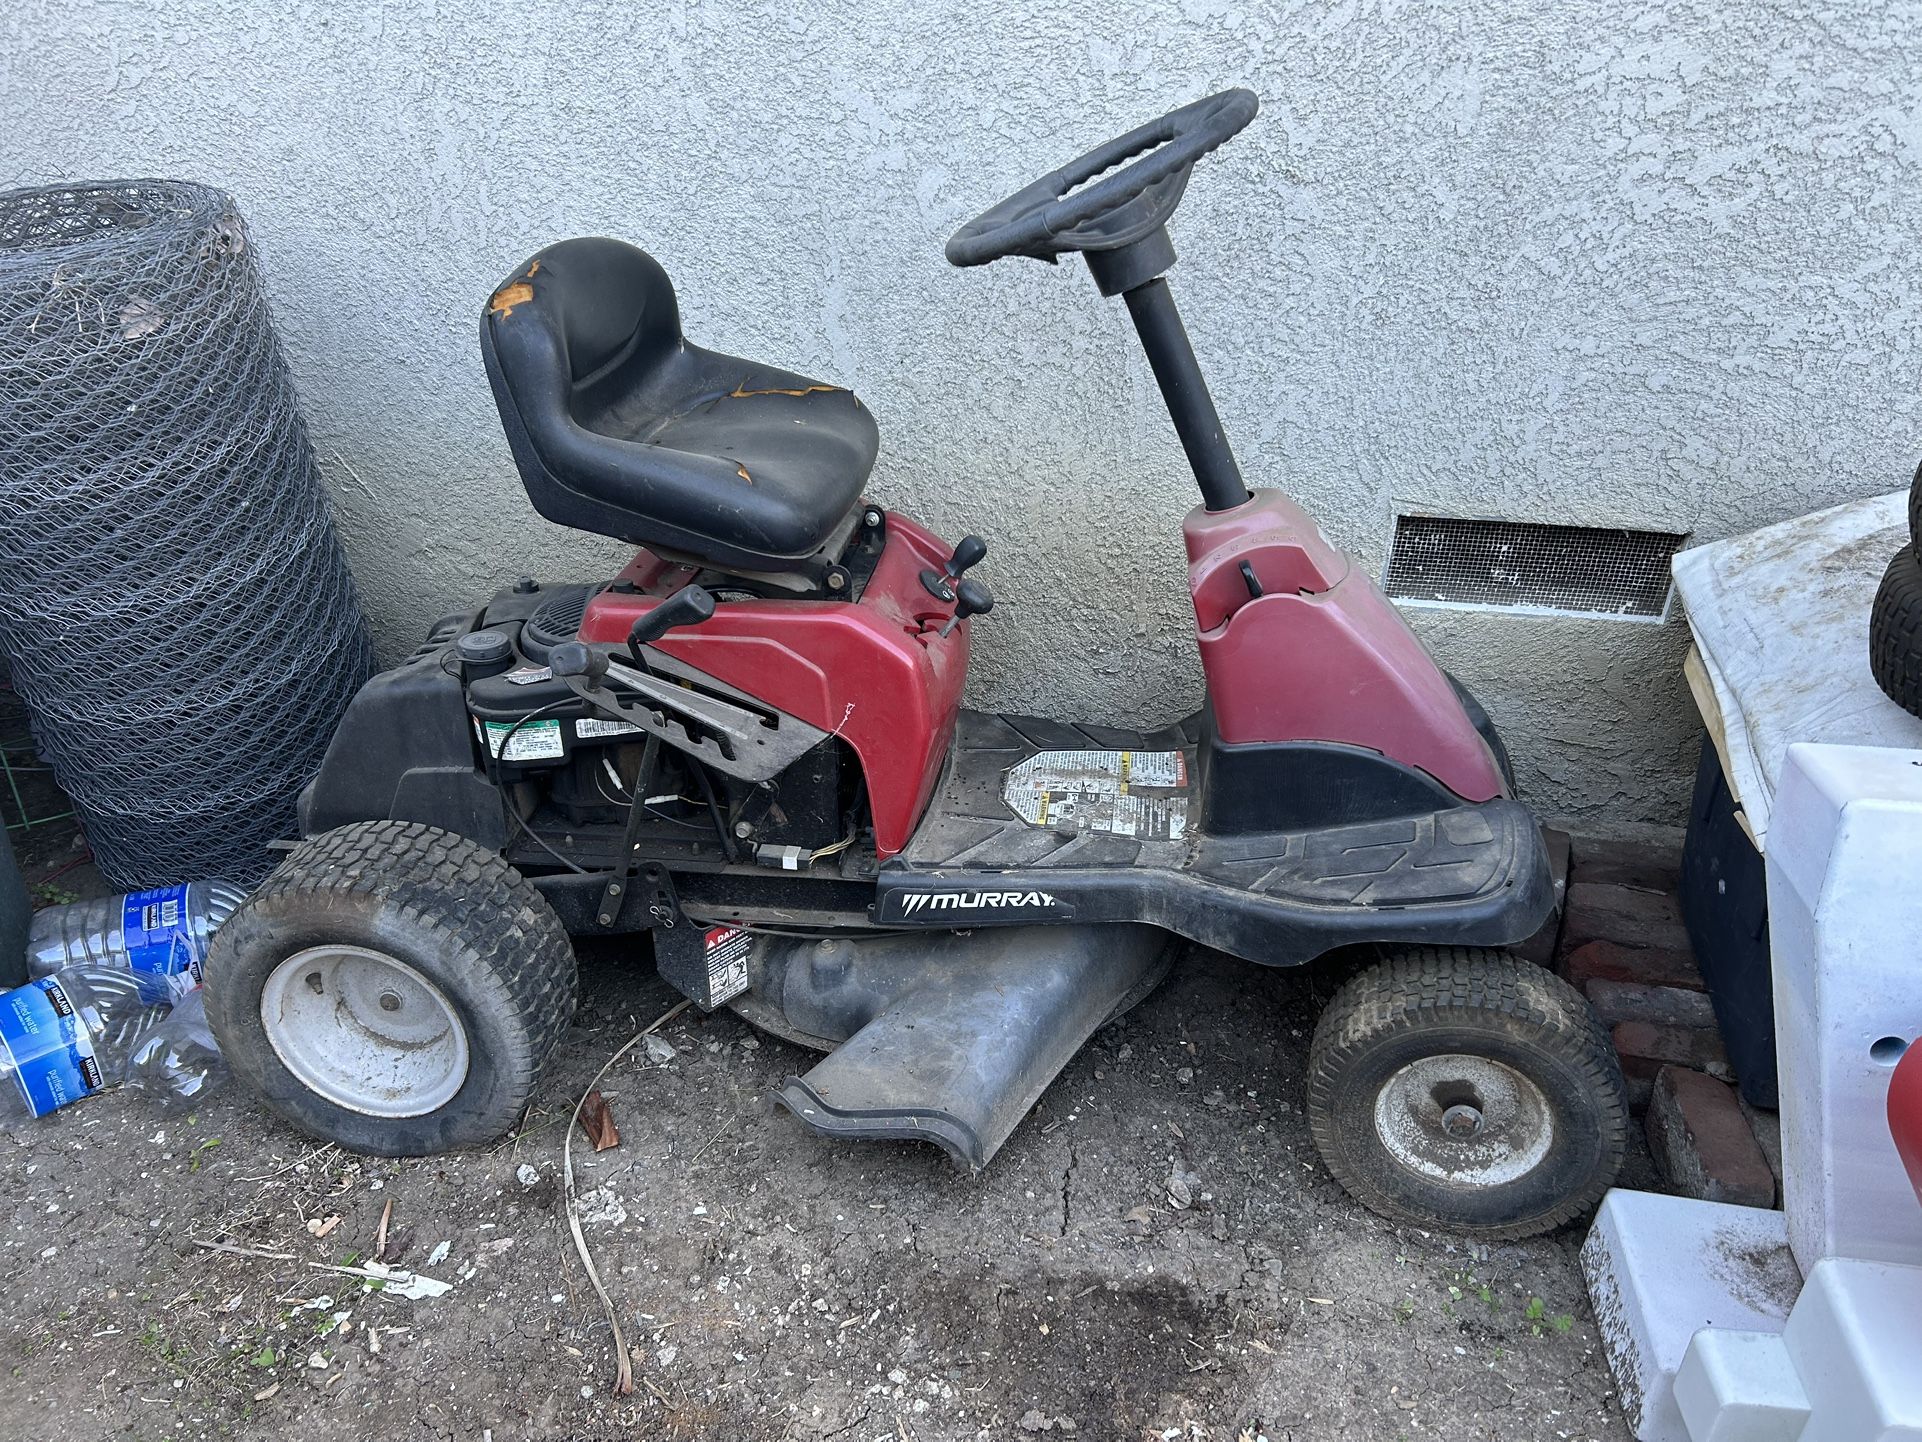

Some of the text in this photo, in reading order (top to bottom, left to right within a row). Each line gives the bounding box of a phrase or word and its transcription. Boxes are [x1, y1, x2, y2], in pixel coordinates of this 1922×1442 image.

[52, 987, 71, 1014] KIRKLAND
[23, 1015, 40, 1035] water
[85, 1059, 100, 1086] KIRKLAND
